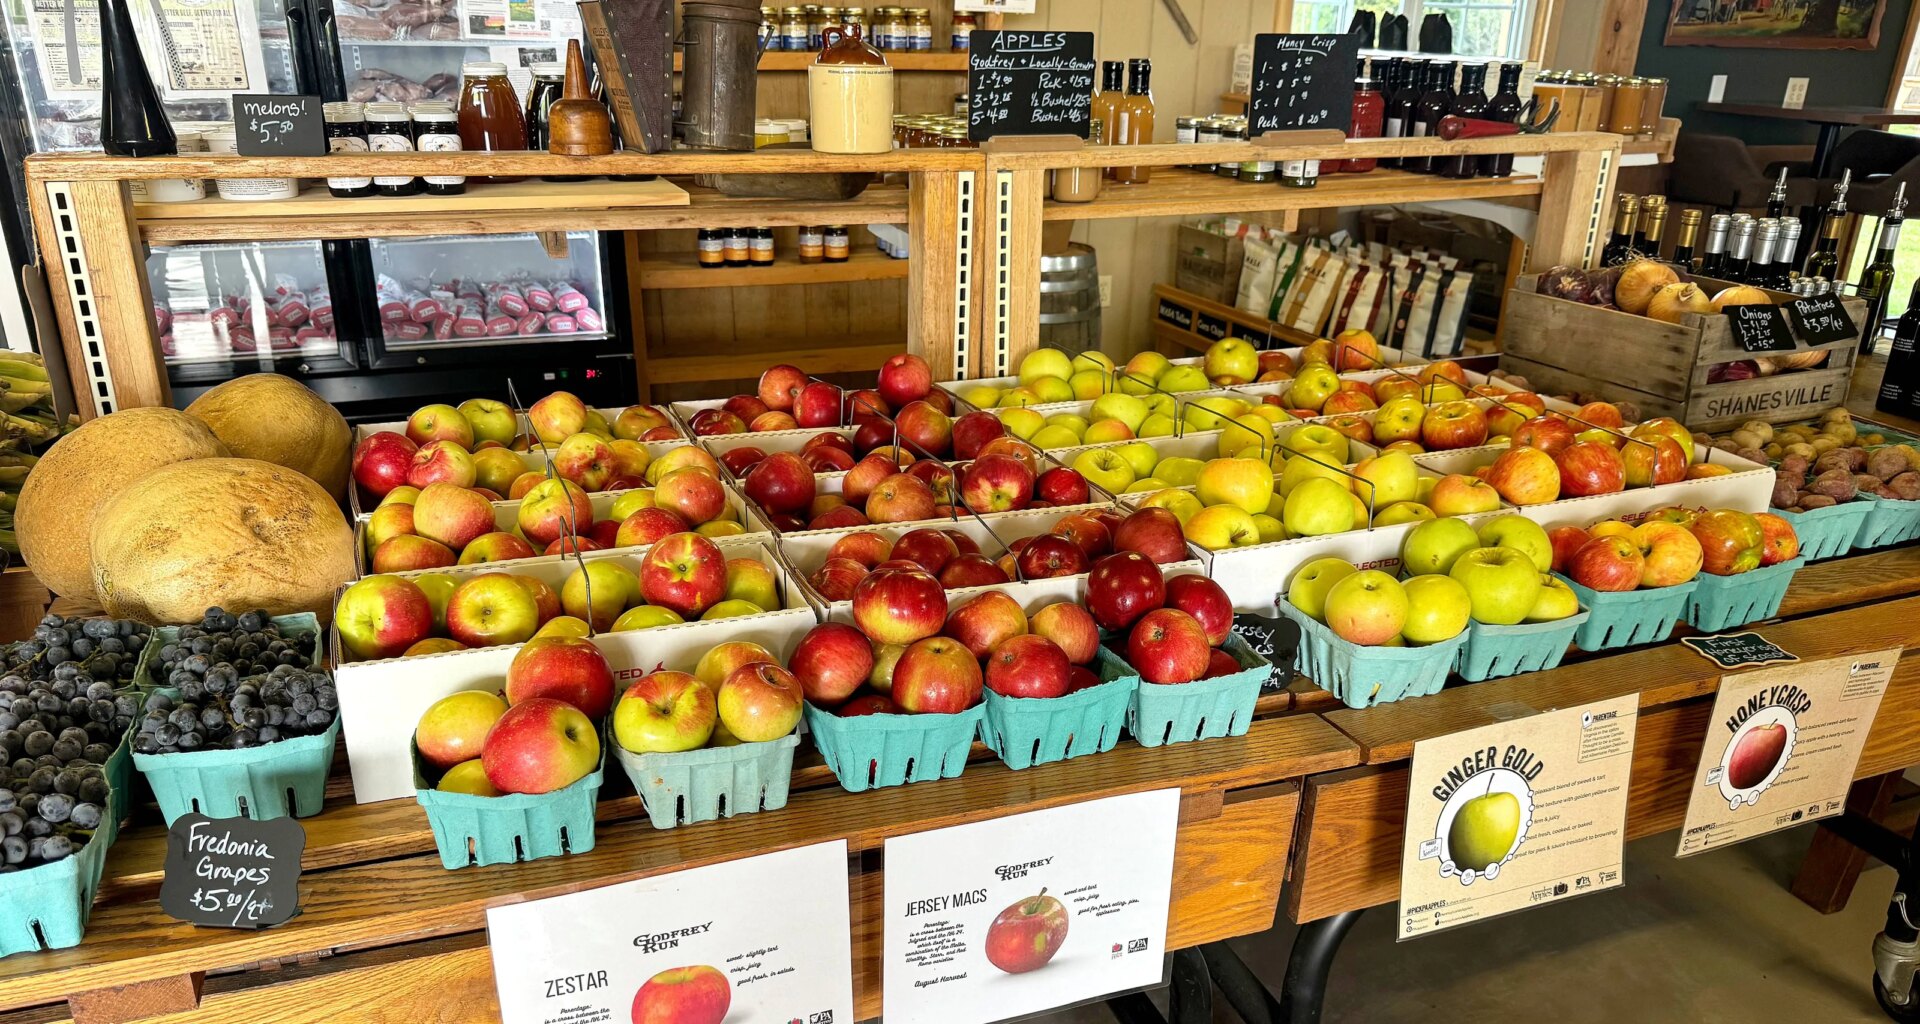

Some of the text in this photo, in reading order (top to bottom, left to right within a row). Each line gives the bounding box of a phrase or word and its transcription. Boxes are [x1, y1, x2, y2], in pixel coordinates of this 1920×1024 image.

[991, 31, 1066, 50] APPLES
[1277, 35, 1336, 55] Honey Crisp
[970, 54, 1015, 71] Godfrey
[1257, 115, 1278, 128] Peck
[1740, 305, 1772, 320] Onions
[1795, 299, 1836, 316] Potatoes
[1705, 383, 1833, 419] SHANESVILLE
[1231, 624, 1275, 645] ersey
[1705, 638, 1746, 648] First
[1592, 710, 1618, 723] PARENTAGE
[1725, 684, 1812, 735] HONEYCRISP
[1432, 744, 1544, 802] GINGER GOLD
[1534, 785, 1556, 796] pleasant
[1556, 782, 1571, 790] blend
[1577, 777, 1592, 786] sweet
[1545, 799, 1563, 808] texture
[1574, 792, 1591, 802] golden
[1591, 789, 1607, 798] yellow
[1548, 814, 1560, 823] juicy
[1577, 820, 1593, 829] baked
[188, 821, 275, 859] Fredonia
[196, 855, 271, 886] Grapes
[995, 855, 1054, 876] GODFREY
[1000, 869, 1028, 882] RUN
[1063, 883, 1098, 896] sweet and tart
[904, 888, 988, 918] JERSEY MACS
[1077, 907, 1091, 916] good
[633, 920, 713, 948] GODFREY
[935, 925, 955, 933] between
[642, 938, 680, 954] RUN
[767, 944, 779, 953] tart
[905, 948, 934, 957] combination
[934, 945, 942, 953] of
[945, 948, 956, 956] and
[745, 961, 762, 971] juicy
[544, 970, 609, 998] ZESTAR
[736, 976, 751, 987] good
[776, 966, 796, 975] salads
[914, 971, 968, 989] August Harvest
[575, 1010, 600, 1019] between
